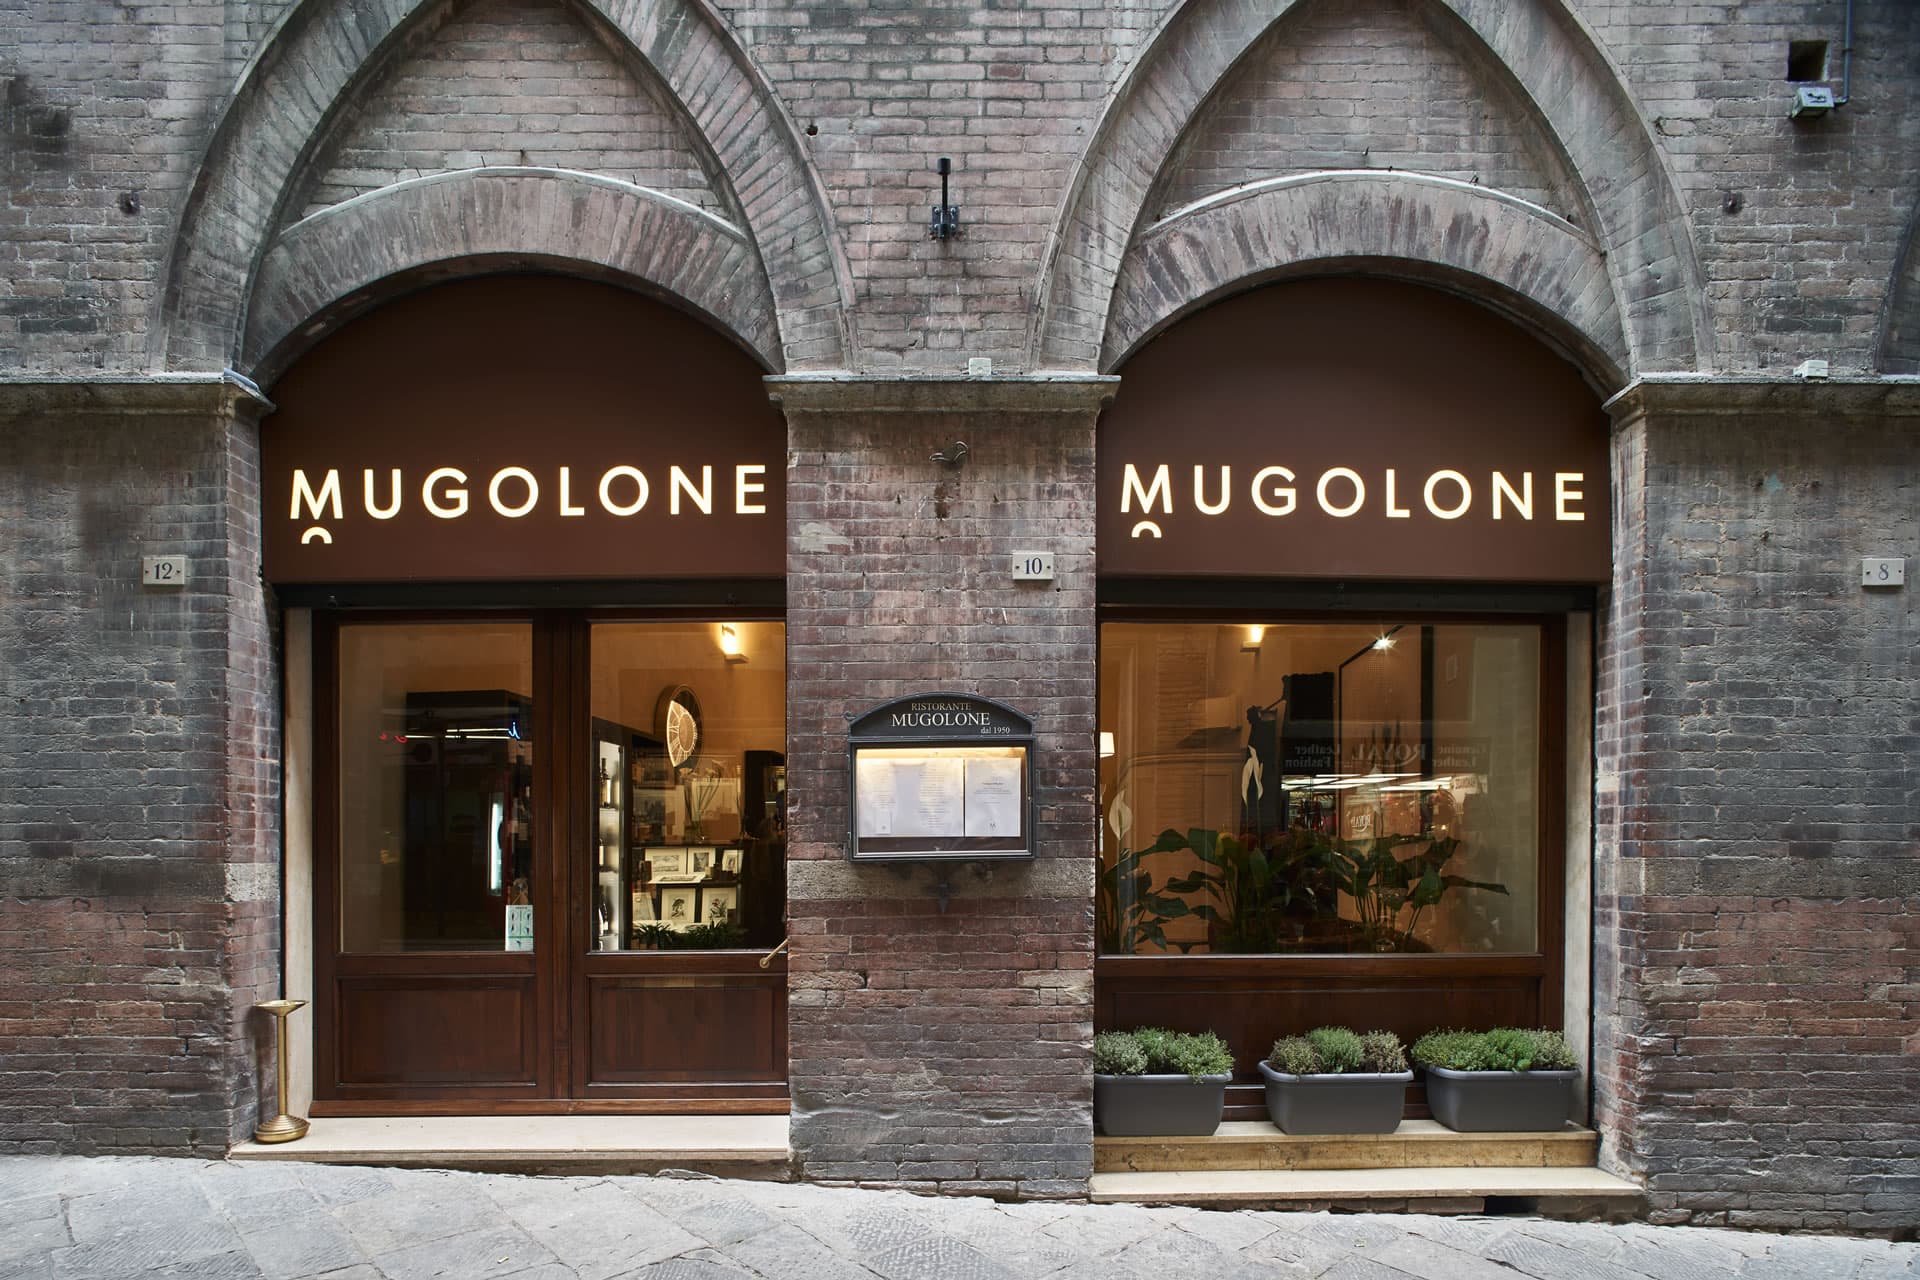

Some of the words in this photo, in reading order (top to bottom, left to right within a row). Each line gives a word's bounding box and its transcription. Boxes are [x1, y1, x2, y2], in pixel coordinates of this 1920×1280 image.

[289, 464, 767, 520] MUGOLONE
[1120, 463, 1585, 521] MUGOLONE
[153, 562, 173, 580] 12
[1024, 557, 1043, 575] 10
[1878, 563, 1889, 581] 8
[911, 702, 972, 712] RISTORANTE
[891, 712, 991, 727] MUGOLONE
[980, 726, 992, 734] dal
[993, 726, 1011, 734] 1950
